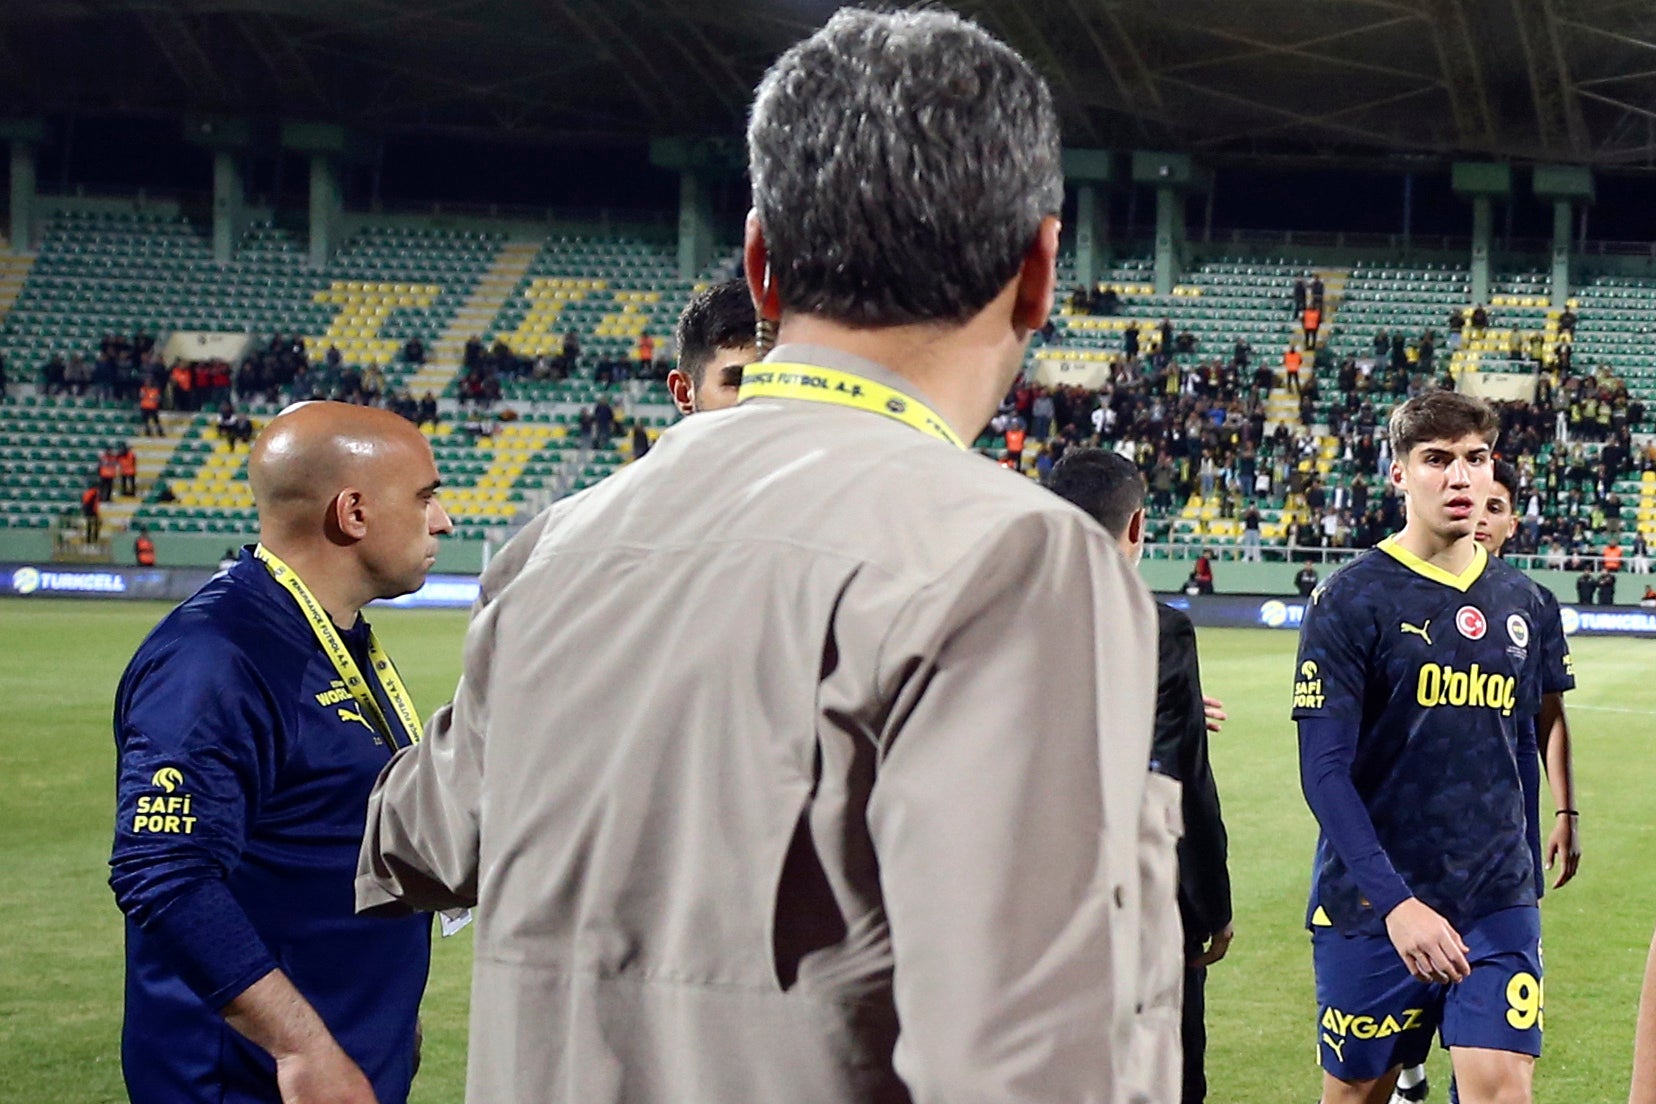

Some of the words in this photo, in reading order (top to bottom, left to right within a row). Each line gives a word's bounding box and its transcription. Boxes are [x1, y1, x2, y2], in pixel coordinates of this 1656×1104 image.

[41, 572, 125, 592] TURKCELL
[315, 687, 353, 706] WORL
[133, 815, 197, 834] PORT
[1506, 972, 1543, 1032] 9
[1321, 1006, 1424, 1040] AYGAZ
